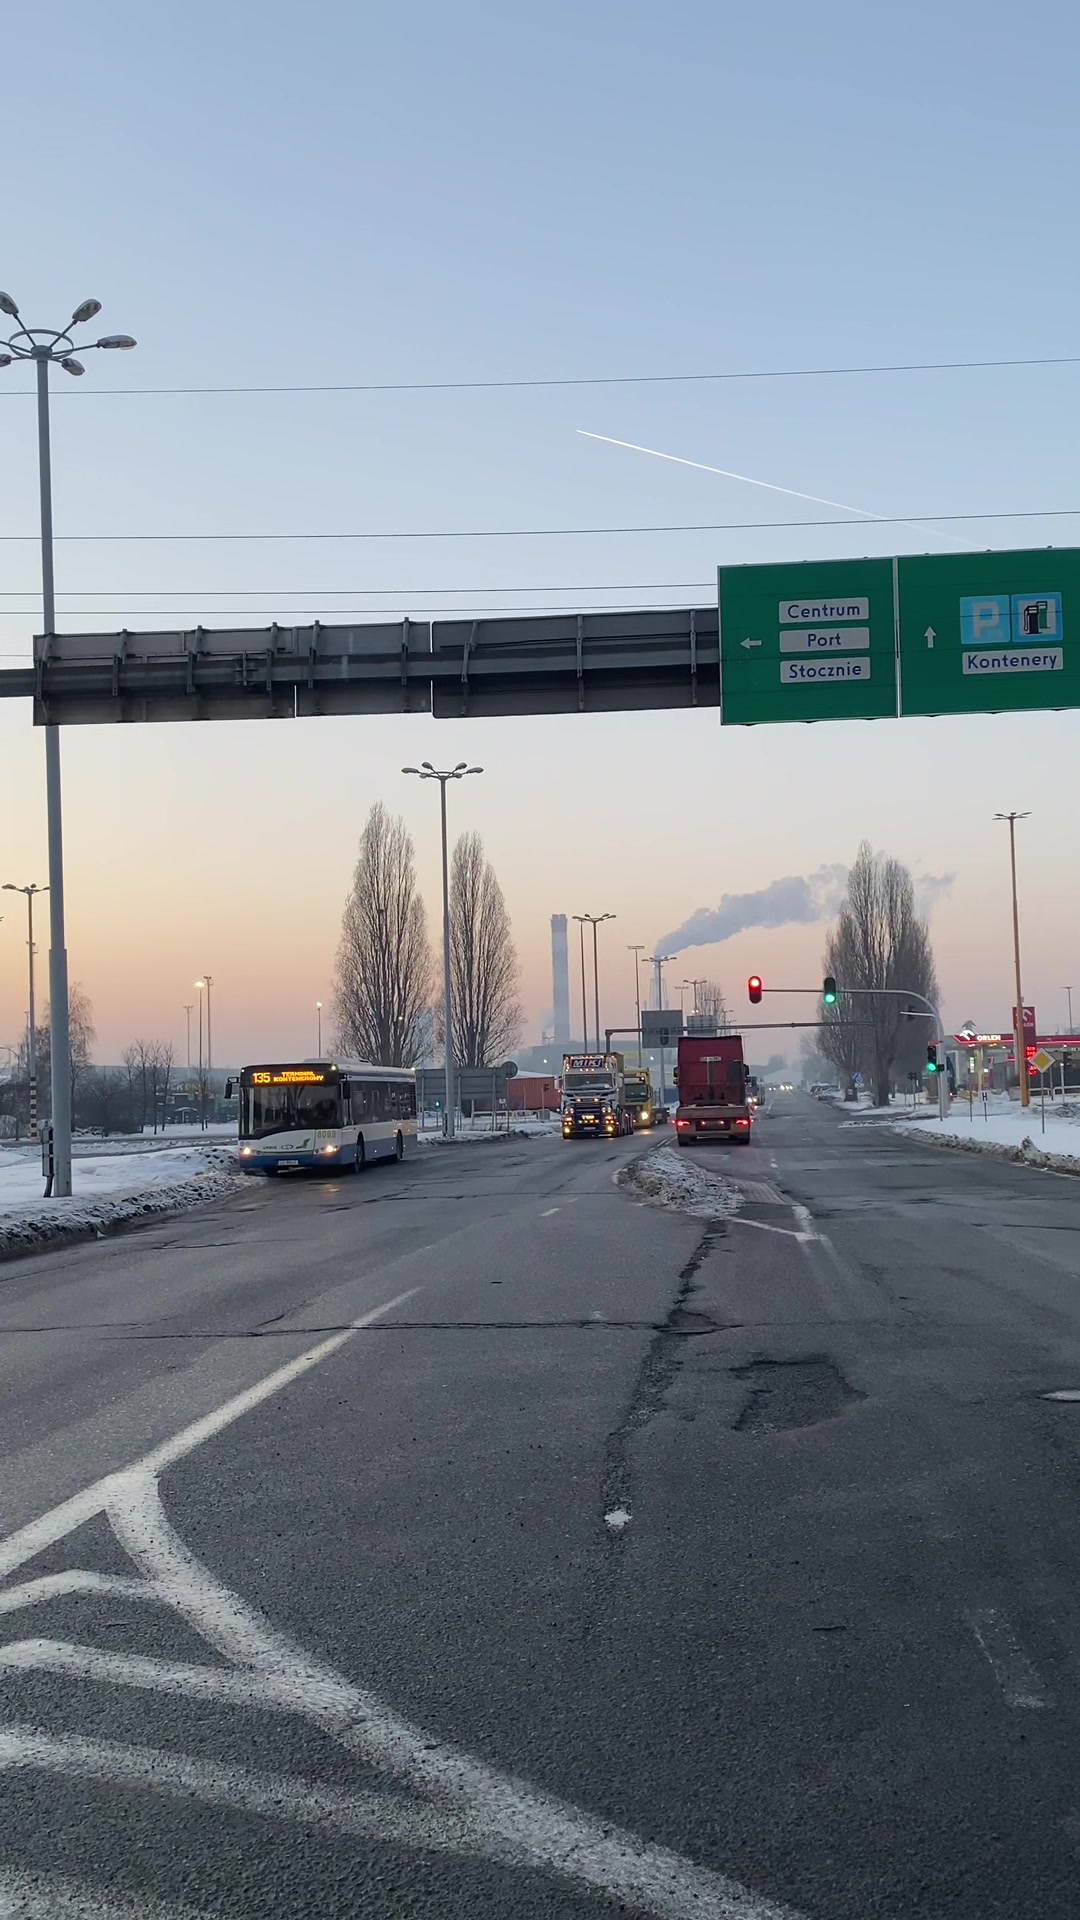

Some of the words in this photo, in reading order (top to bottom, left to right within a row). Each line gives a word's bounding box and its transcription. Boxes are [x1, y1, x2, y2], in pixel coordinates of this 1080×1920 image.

[787, 601, 861, 620] Centrum
[807, 632, 842, 648] Port
[788, 661, 863, 678] Stocznie
[967, 652, 1058, 671] Kontenery
[252, 1072, 271, 1083] 135
